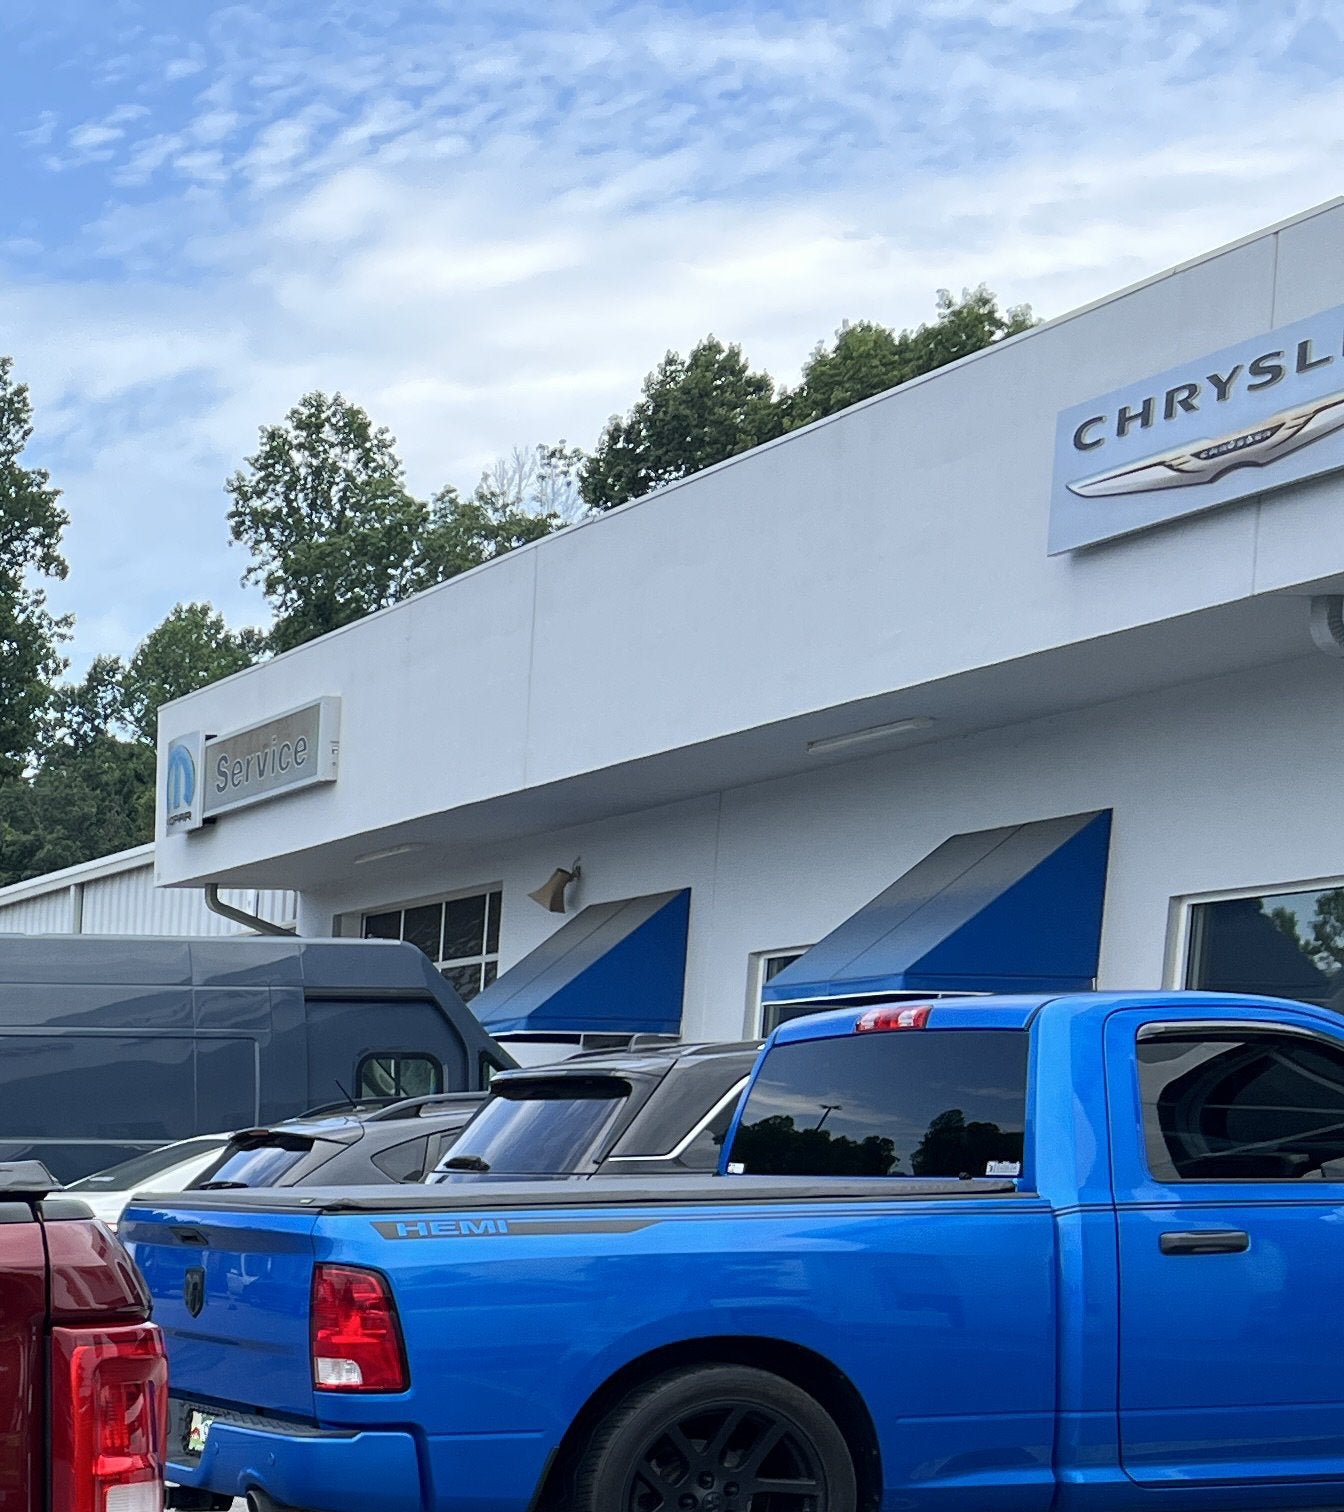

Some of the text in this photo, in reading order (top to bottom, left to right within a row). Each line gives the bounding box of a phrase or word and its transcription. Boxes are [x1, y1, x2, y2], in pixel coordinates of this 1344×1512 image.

[1073, 339, 1344, 451] CHRYSL
[216, 735, 308, 794] Service
[396, 1219, 508, 1236] HEMI
